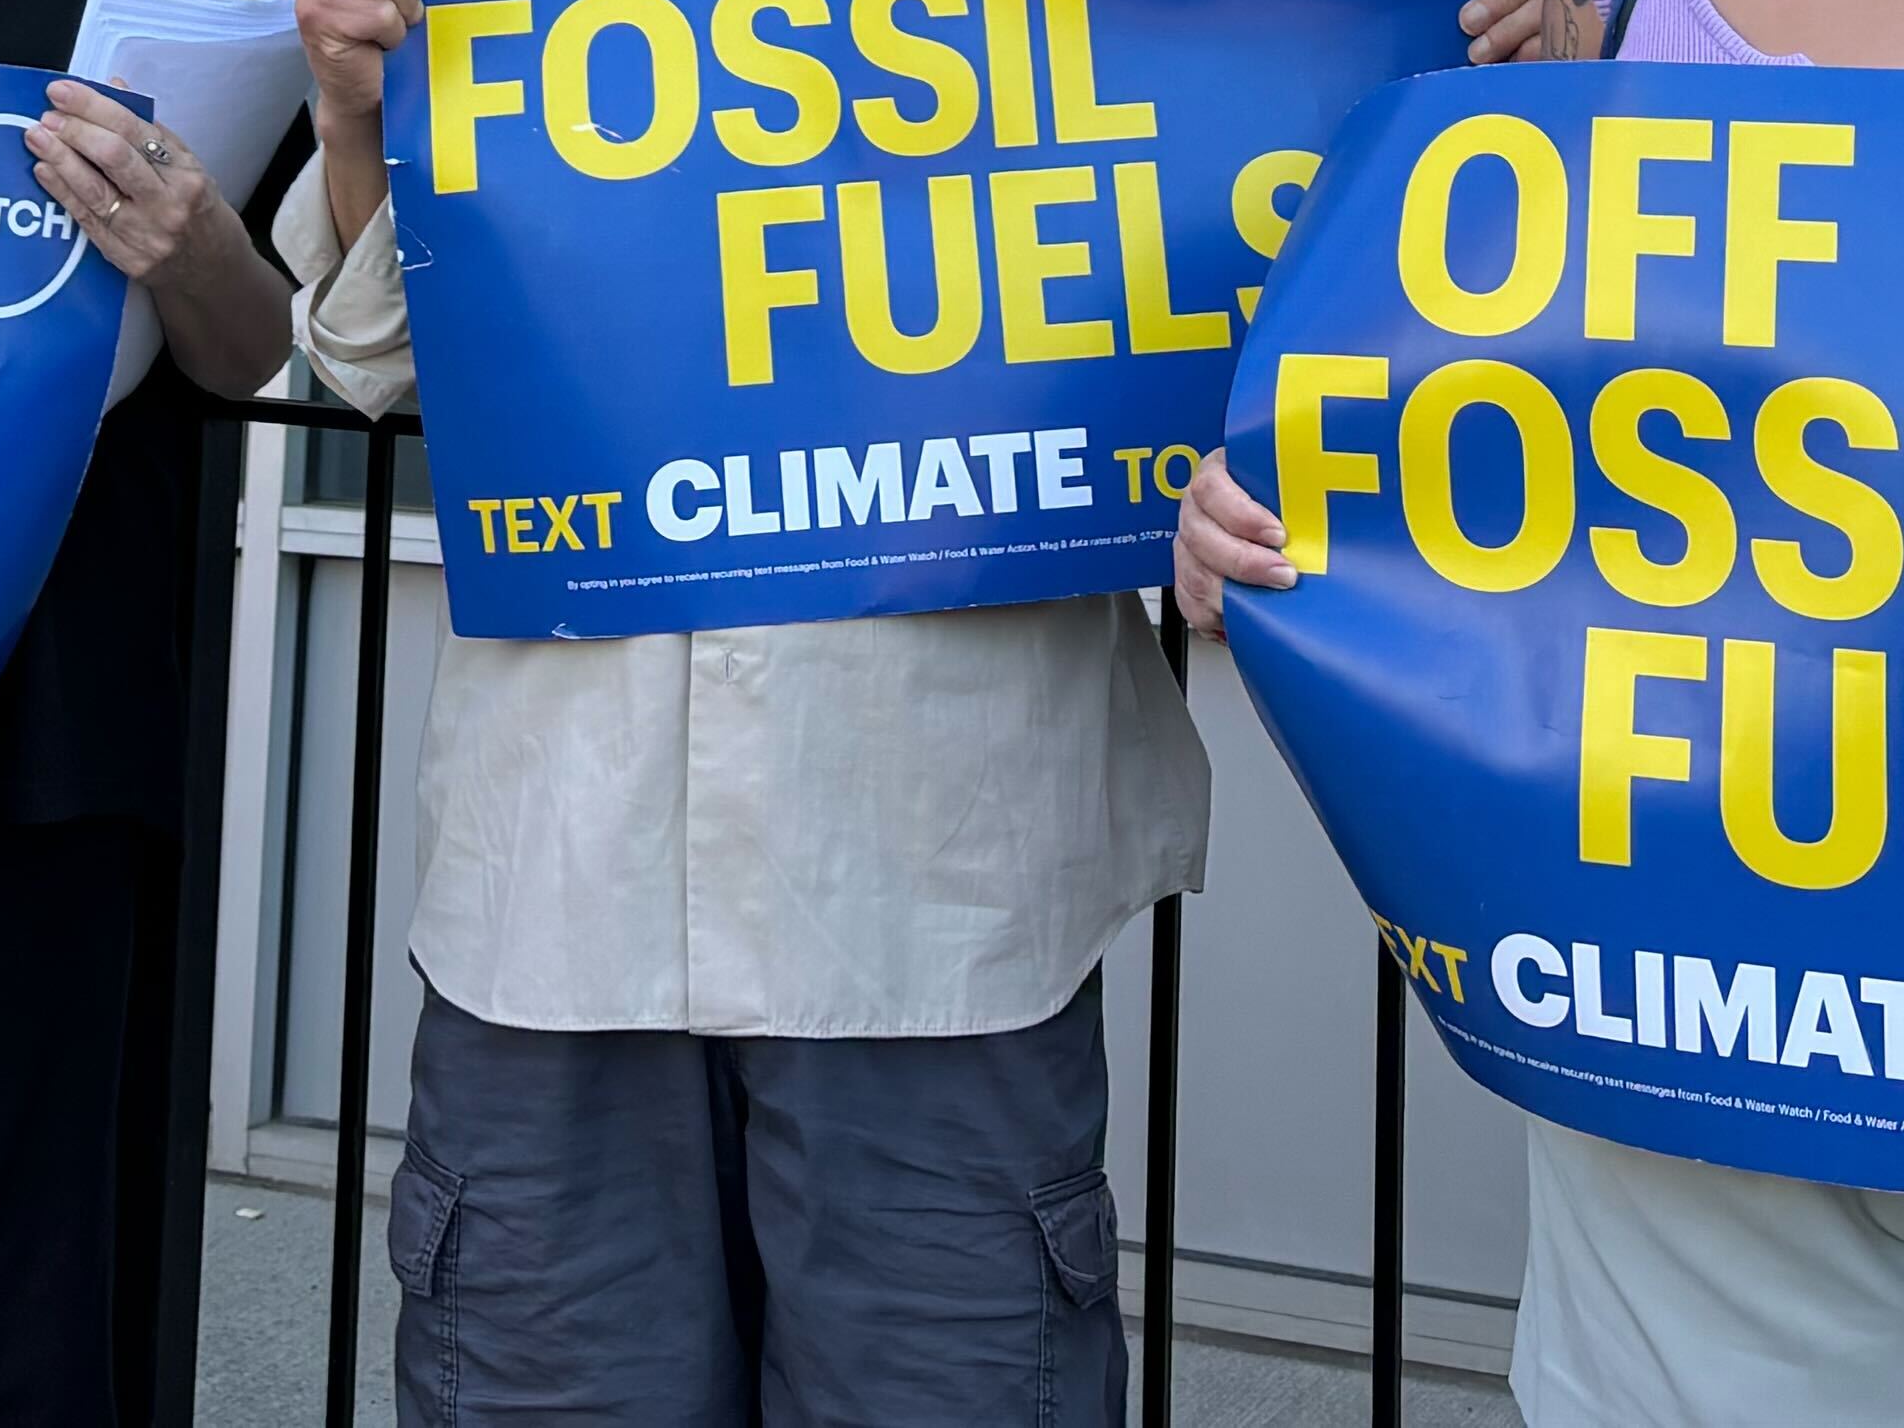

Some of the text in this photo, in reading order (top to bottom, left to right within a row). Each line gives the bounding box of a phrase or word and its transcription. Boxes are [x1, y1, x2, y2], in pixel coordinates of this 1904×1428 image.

[716, 150, 1323, 386] FUELS
[1396, 114, 1856, 347] OFF
[468, 426, 1202, 555] TEXT CLIMATE TO
[1823, 1109, 1852, 1125] Food
[1865, 1115, 1898, 1131] Water
